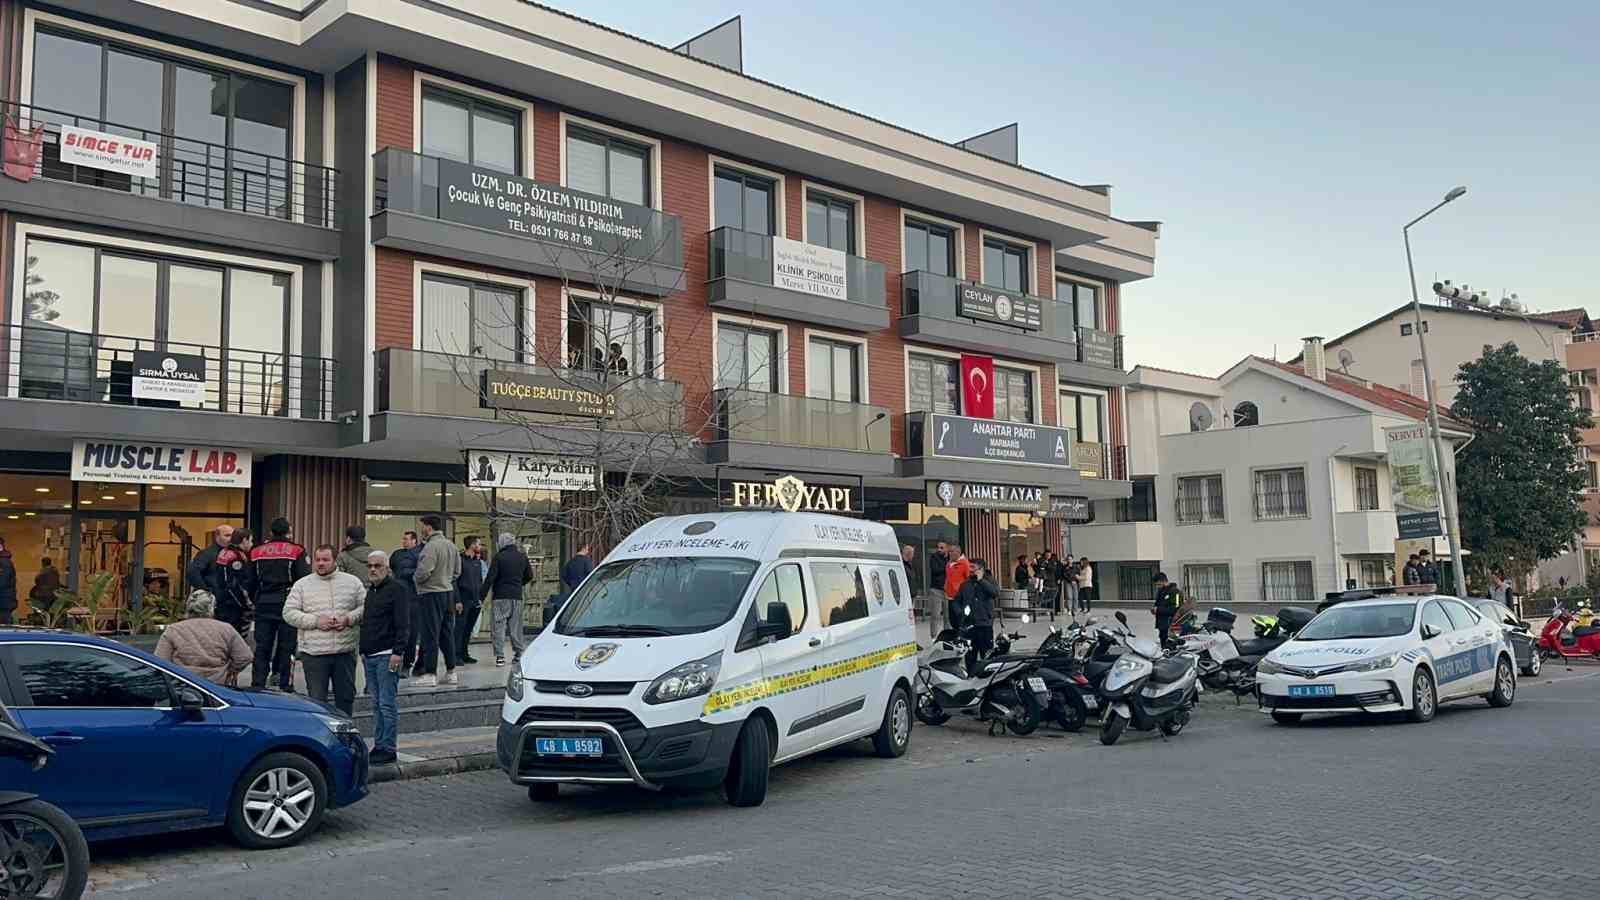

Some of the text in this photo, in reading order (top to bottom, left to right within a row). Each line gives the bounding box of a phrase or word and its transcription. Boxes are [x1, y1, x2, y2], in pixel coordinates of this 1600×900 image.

[471, 172, 623, 220] UZM. DR. ÖZLEM YILDIRIM
[448, 184, 642, 241] Çocuk Ve Genç Psikiyatristi & Psikoterapist
[508, 219, 529, 232] TEL:
[531, 223, 551, 237] 0531
[964, 289, 993, 303] CEYLAN
[171, 371, 200, 381] UYSAL
[491, 382, 615, 407] TUĞÇE BEAUTY STUDO
[972, 423, 1012, 437] ANAHTAR
[83, 442, 243, 476] MUSCLE LAB.
[802, 486, 852, 512] YAPI
[963, 484, 1042, 501] AHMET AYAR
[562, 740, 569, 752] A
